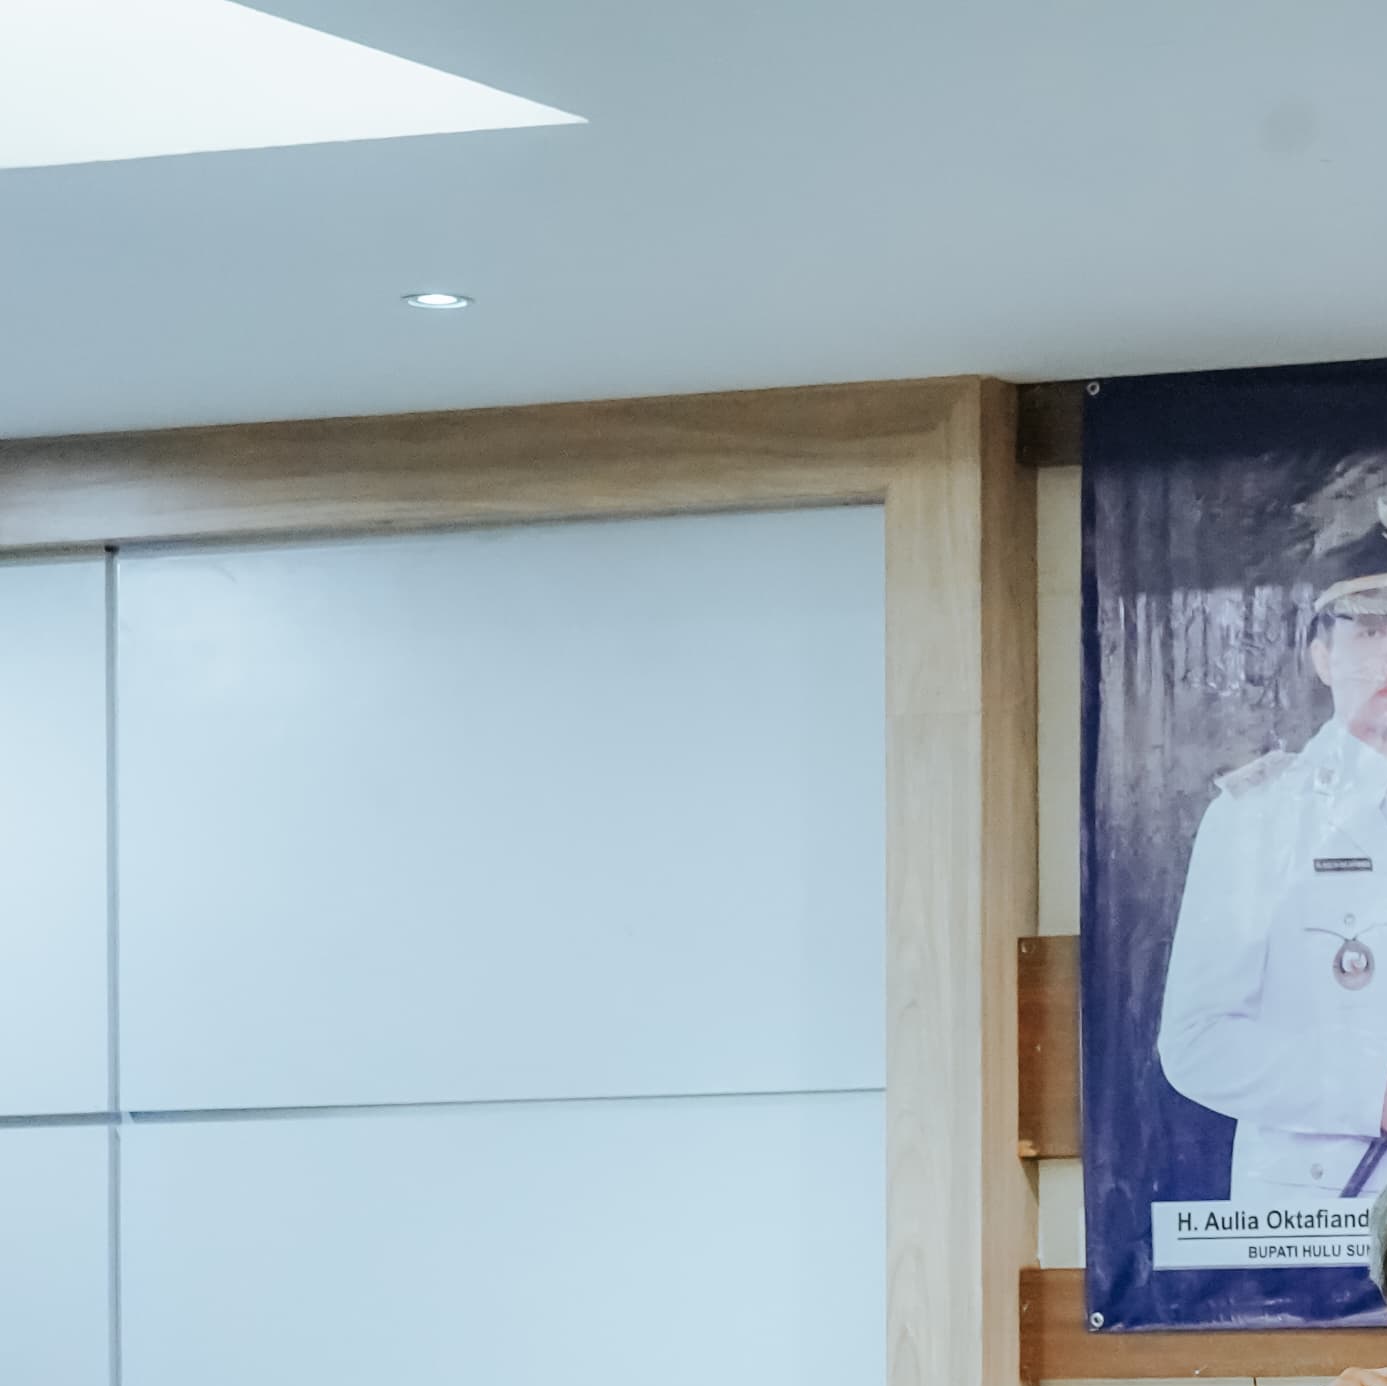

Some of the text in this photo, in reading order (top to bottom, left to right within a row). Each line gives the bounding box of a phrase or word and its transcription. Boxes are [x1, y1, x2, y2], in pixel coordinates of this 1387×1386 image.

[1177, 1208, 1370, 1231] H. Aulia Oktafiand
[1249, 1246, 1298, 1259] BUPATI
[1302, 1245, 1341, 1258] HULU
